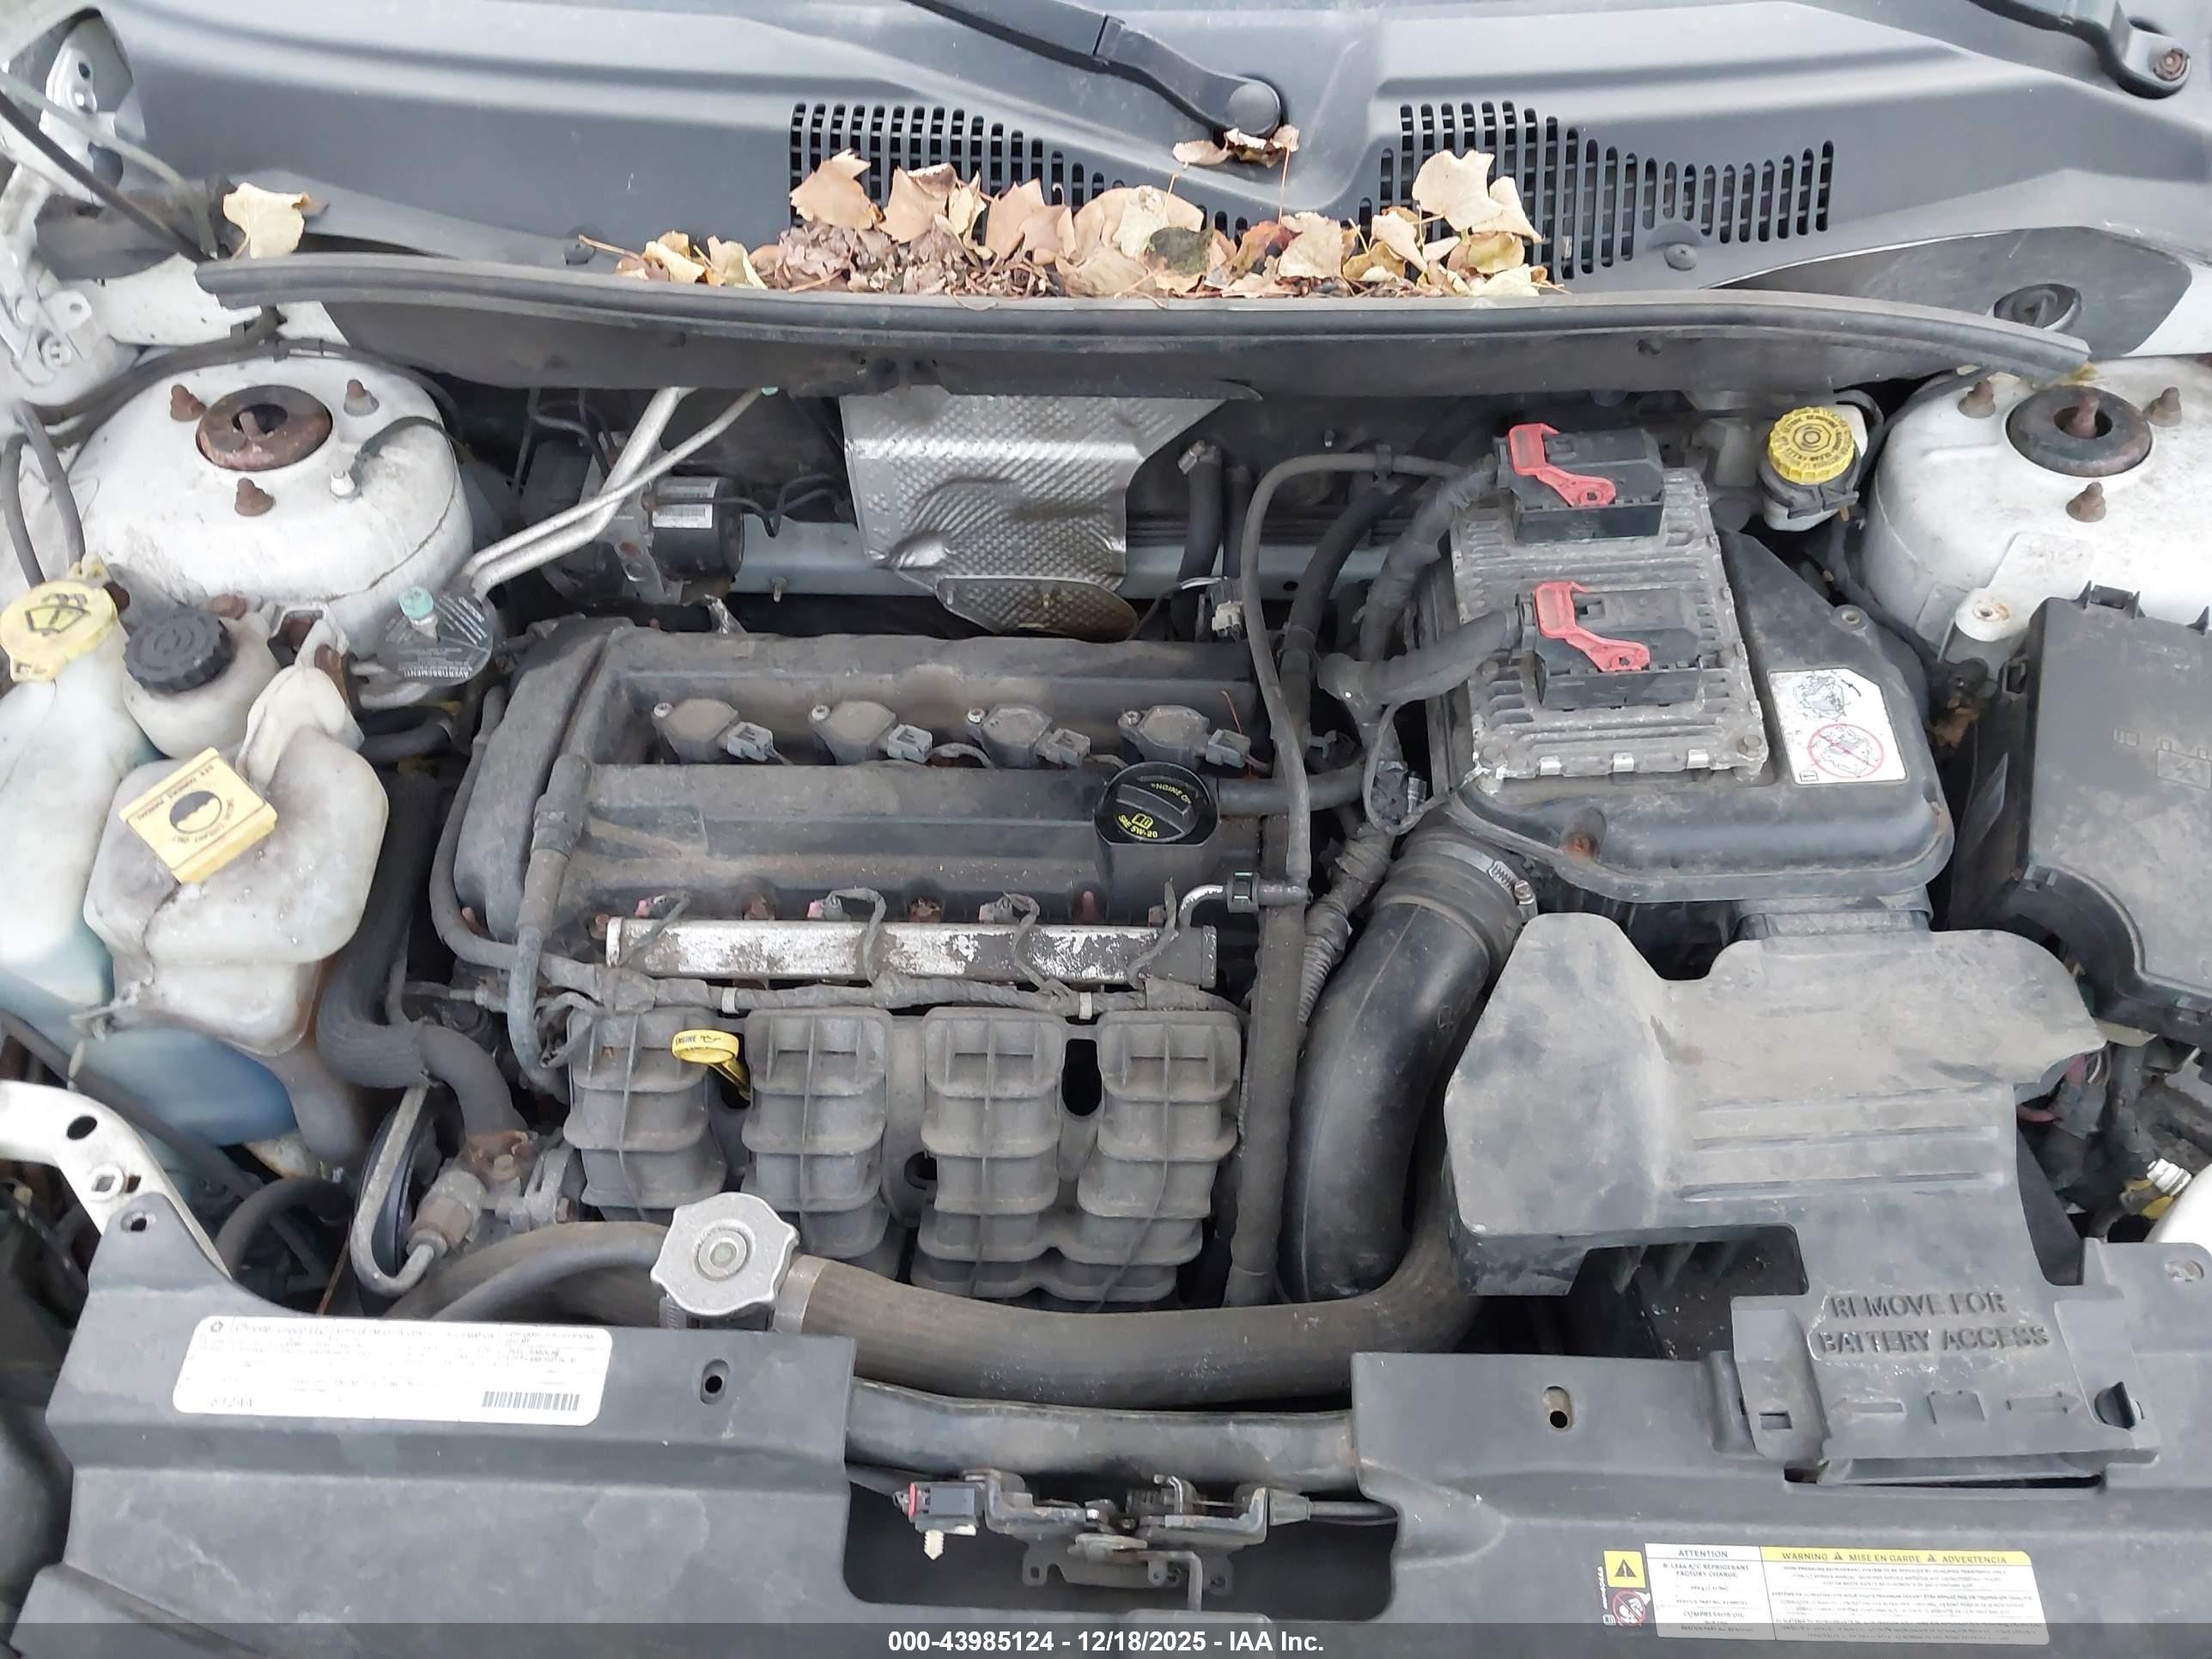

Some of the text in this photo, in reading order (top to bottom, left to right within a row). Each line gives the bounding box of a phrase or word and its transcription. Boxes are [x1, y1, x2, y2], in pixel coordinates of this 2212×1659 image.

[1118, 814, 1158, 838] SAE 5W-20
[675, 1036, 696, 1046] ENGINE
[1830, 1291, 2007, 1318] REMOVE FOR
[1818, 1325, 2050, 1353] BATTERY ACCESS
[1678, 1549, 1729, 1558] ATTENTION
[1782, 1552, 2008, 1565] WARNING MISE EN GARDE ADVERTENCIA
